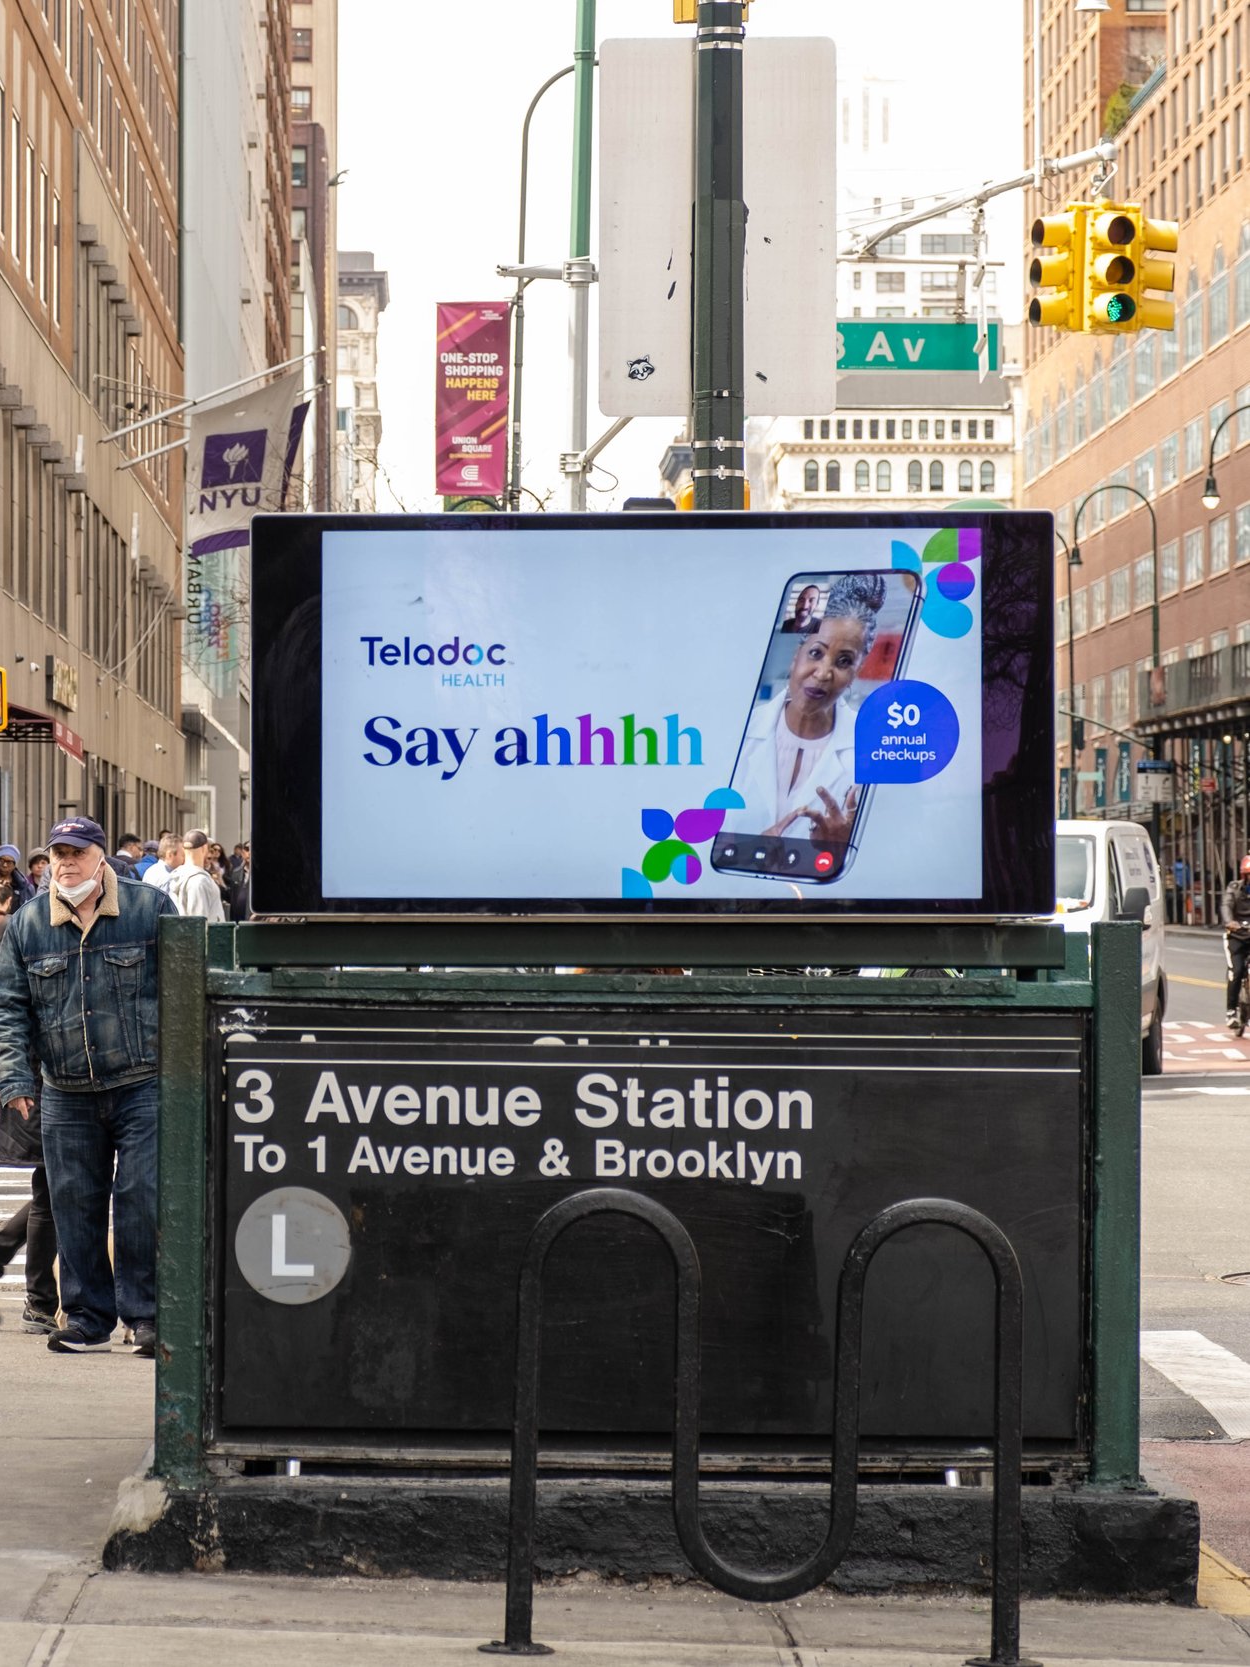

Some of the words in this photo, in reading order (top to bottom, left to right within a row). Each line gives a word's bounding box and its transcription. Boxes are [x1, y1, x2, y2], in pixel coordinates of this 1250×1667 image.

[865, 330, 926, 362] Av
[440, 352, 499, 363] ONE-STOP
[444, 365, 504, 376] SHOPPING
[445, 377, 499, 389] HAPPENS
[466, 390, 497, 401] HERE
[451, 435, 478, 445] UNION
[461, 444, 493, 454] SQUARE
[199, 486, 261, 514] NYU
[360, 636, 507, 667] Teladoc
[441, 673, 505, 688] HEALTH
[887, 701, 921, 729] $0
[363, 715, 480, 781] Say
[494, 712, 705, 766] ahhhh
[881, 733, 927, 746] annual
[871, 748, 937, 763] checkups
[234, 1069, 276, 1124] 3
[304, 1071, 543, 1128] Avenue
[574, 1072, 813, 1130] Station
[234, 1134, 287, 1173] To
[306, 1135, 327, 1173] 1
[347, 1136, 517, 1176] Avenue
[538, 1137, 572, 1177] &
[595, 1139, 802, 1186] Brooklyn
[271, 1214, 315, 1277] L
